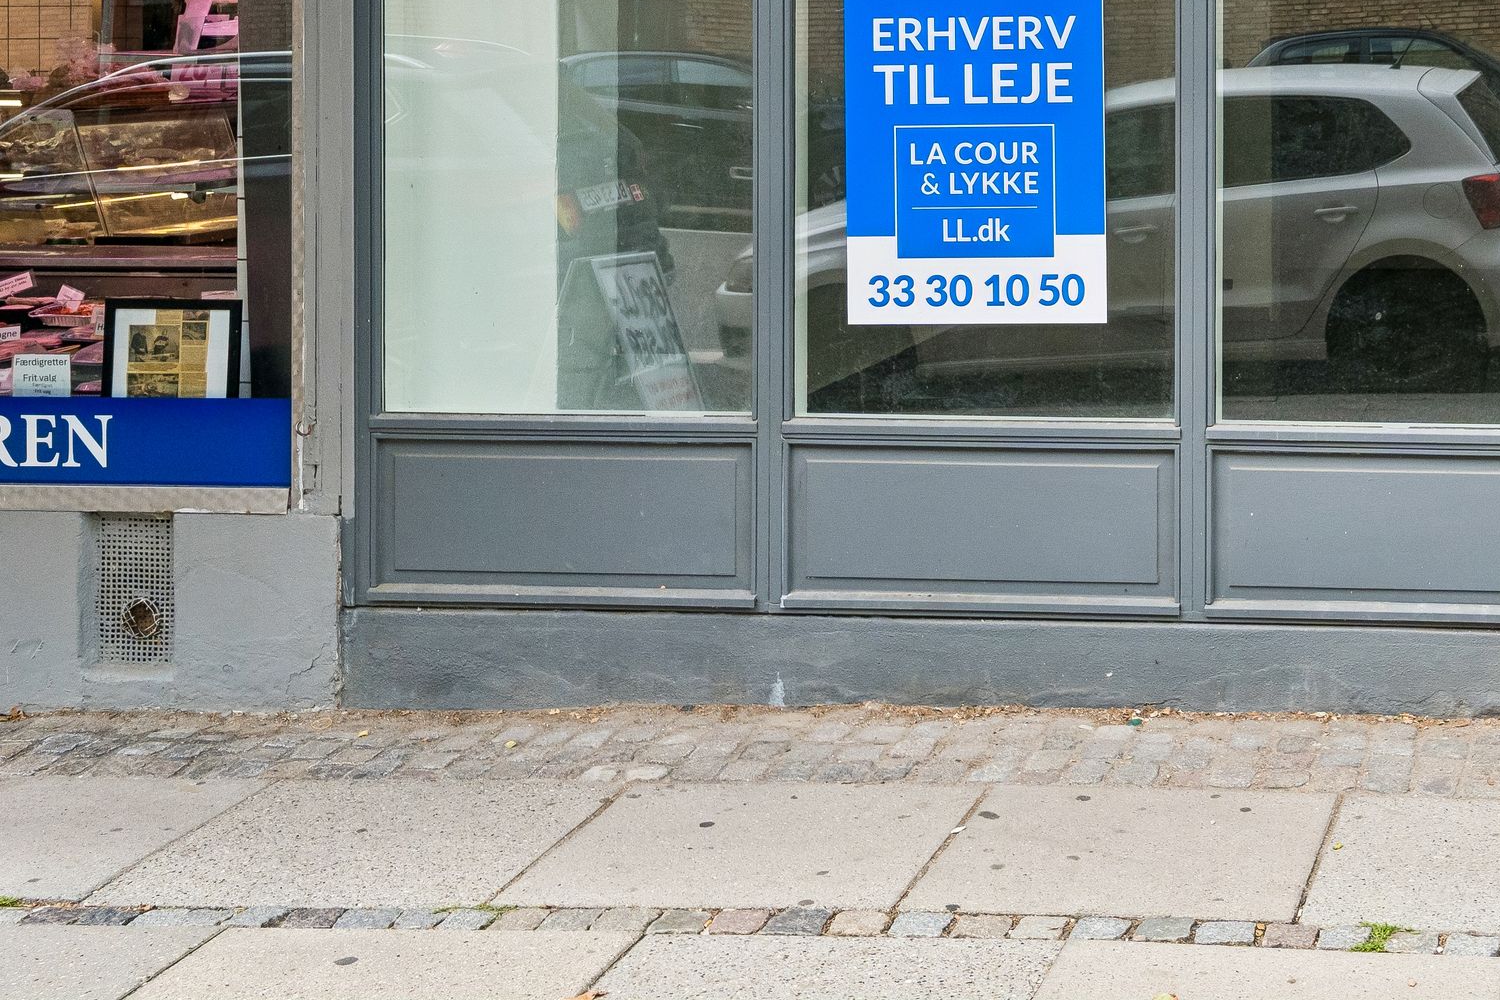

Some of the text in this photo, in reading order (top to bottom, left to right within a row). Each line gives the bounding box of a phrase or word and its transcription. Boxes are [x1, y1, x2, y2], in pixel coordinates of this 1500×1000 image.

[872, 15, 1077, 52] ERHVERV
[872, 62, 1073, 105] TIL LEJE
[910, 141, 1040, 166] LA COUR
[920, 171, 1039, 196] & LYKKE
[942, 217, 1011, 243] LL.dk
[867, 273, 1086, 308] 33 30 10 50
[0, 331, 17, 340] gne
[15, 358, 68, 368] Færdigretter
[23, 374, 57, 382] Frit valg
